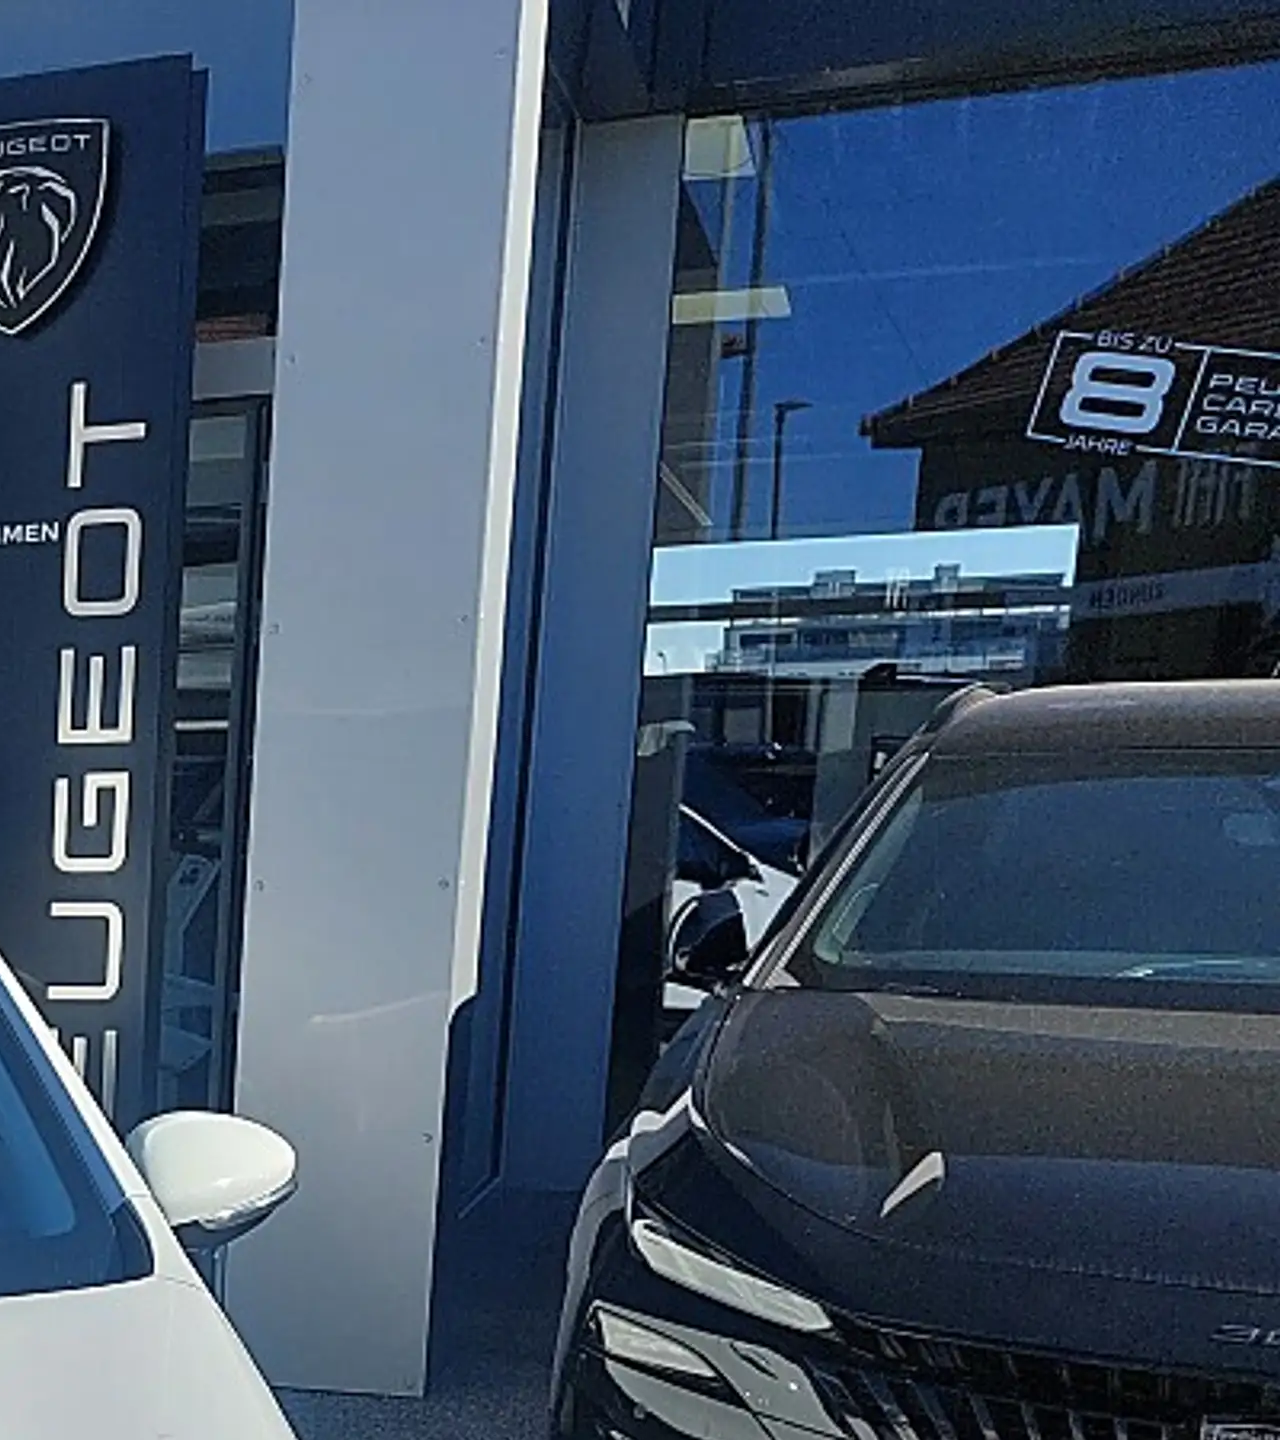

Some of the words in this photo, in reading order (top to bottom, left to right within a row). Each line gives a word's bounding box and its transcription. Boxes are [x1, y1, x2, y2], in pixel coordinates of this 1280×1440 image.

[1096, 330, 1134, 350] BIS
[1058, 351, 1176, 434] 8
[1202, 393, 1280, 417] CAR
[1064, 435, 1133, 456] JAHRE
